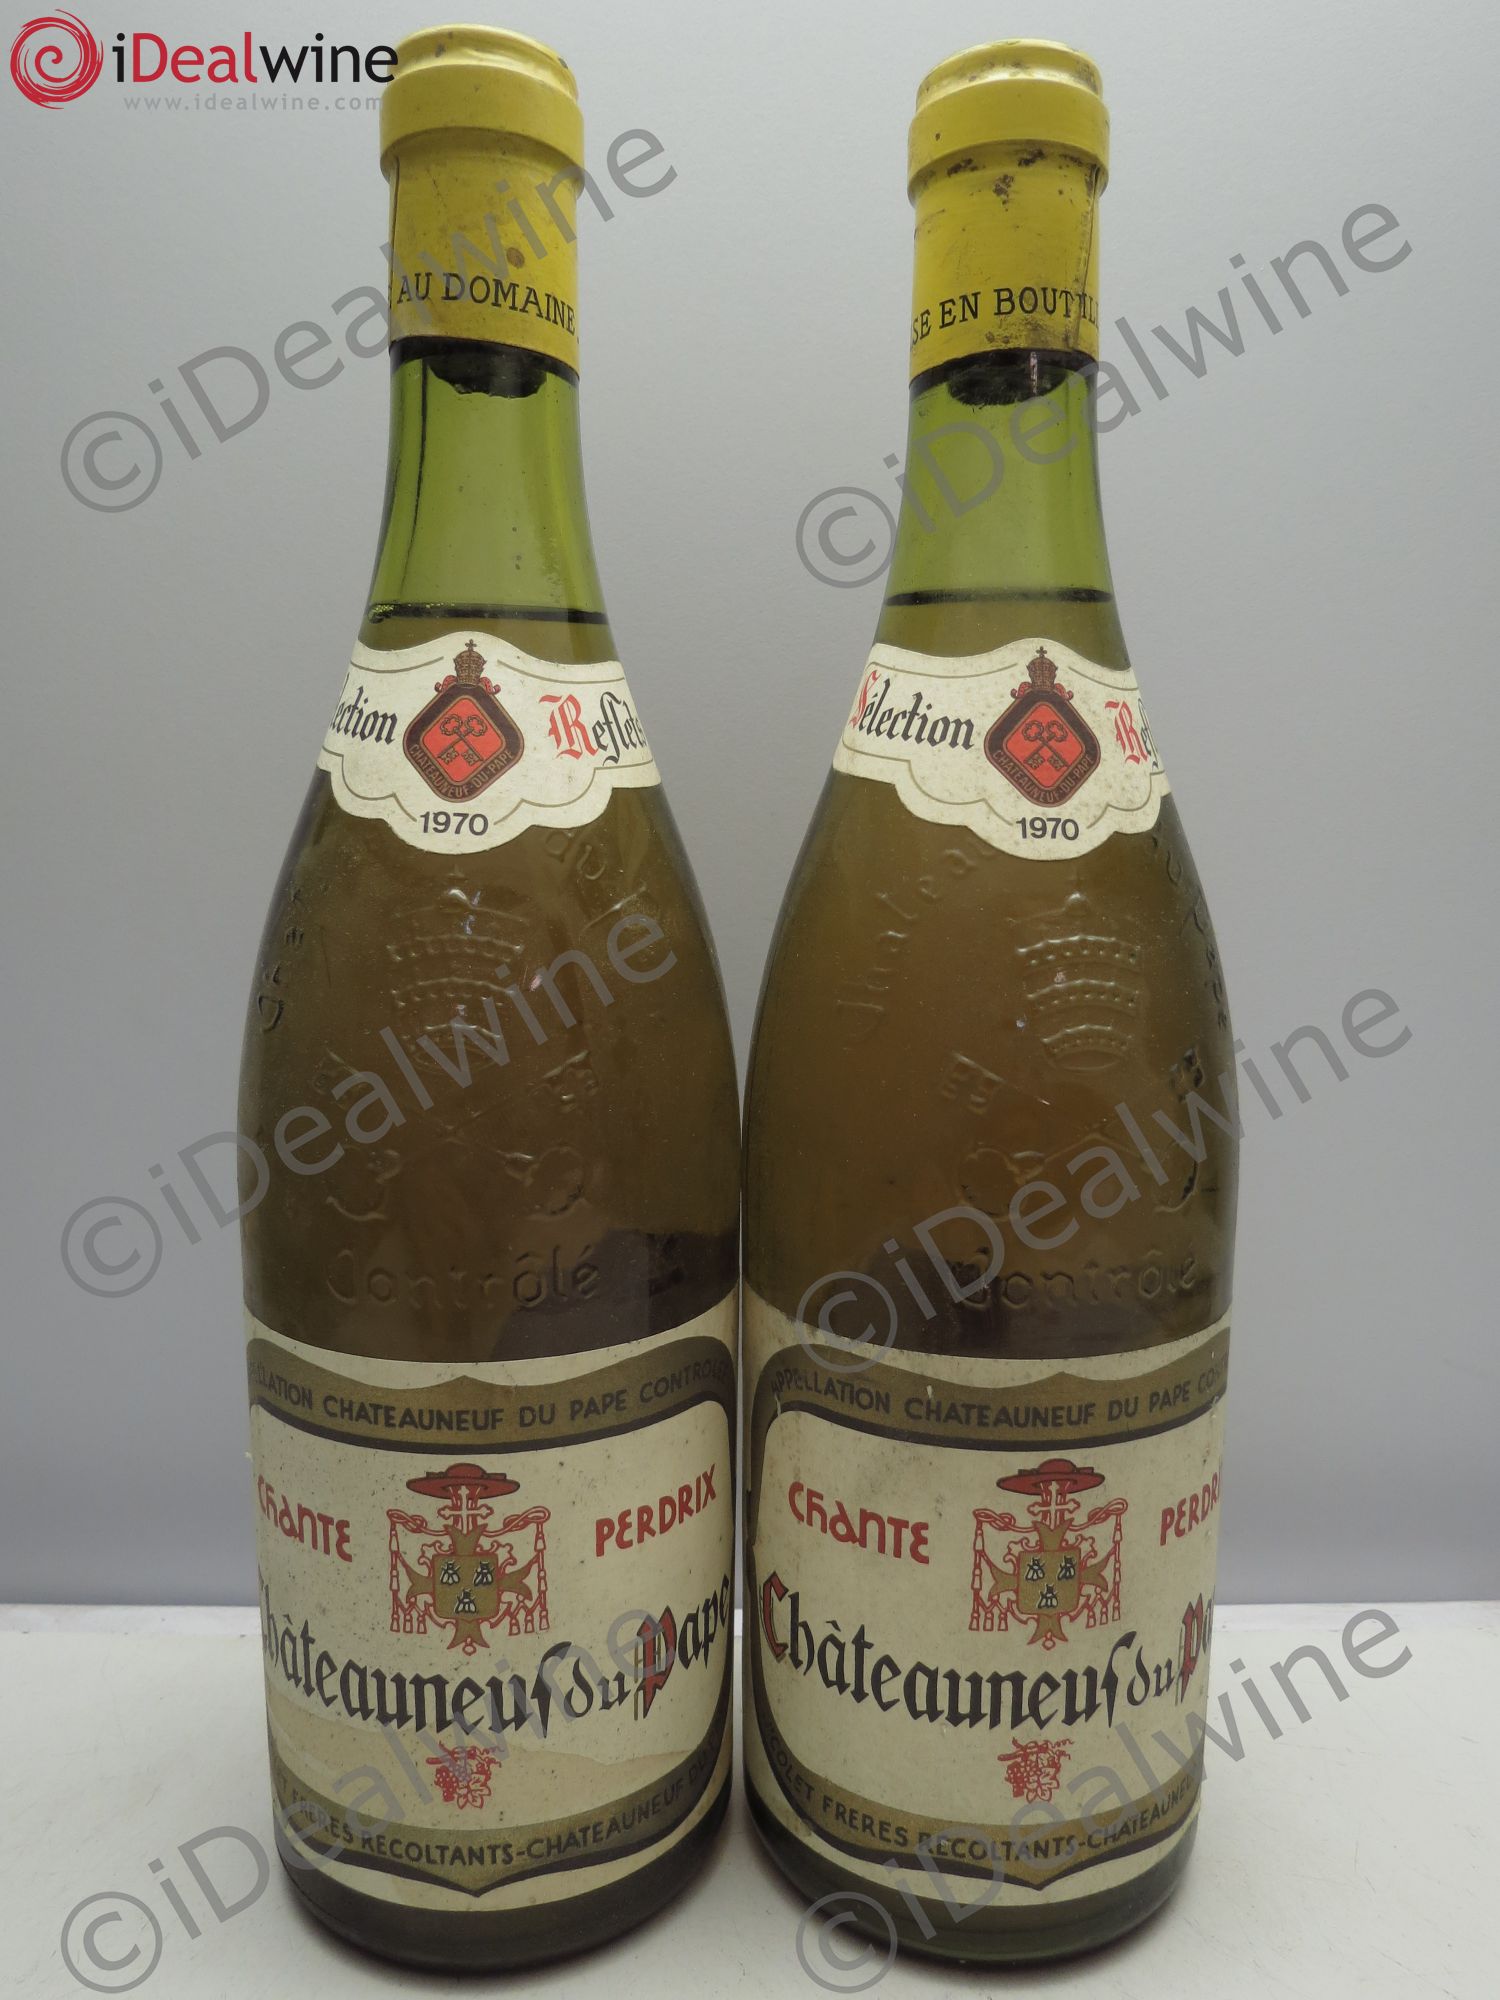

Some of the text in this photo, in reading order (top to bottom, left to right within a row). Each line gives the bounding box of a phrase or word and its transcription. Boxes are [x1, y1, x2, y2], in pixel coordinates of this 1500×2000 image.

[397, 272, 576, 335] AU DOMAINE
[939, 292, 981, 329] EN
[420, 811, 489, 836] 1970
[1016, 816, 1079, 841] 1970
[323, 1395, 502, 1432] CHATEAUNEUF
[519, 1402, 556, 1428] DU
[569, 1389, 627, 1421] PAPE
[903, 1396, 1096, 1430] CHATEAUNEUF
[1108, 1397, 1139, 1422] DU
[1149, 1380, 1191, 1413] PAPE
[595, 1463, 717, 1557] PERDRIX
[634, 1573, 730, 1721] Pape
[822, 1795, 909, 1847] FRERES
